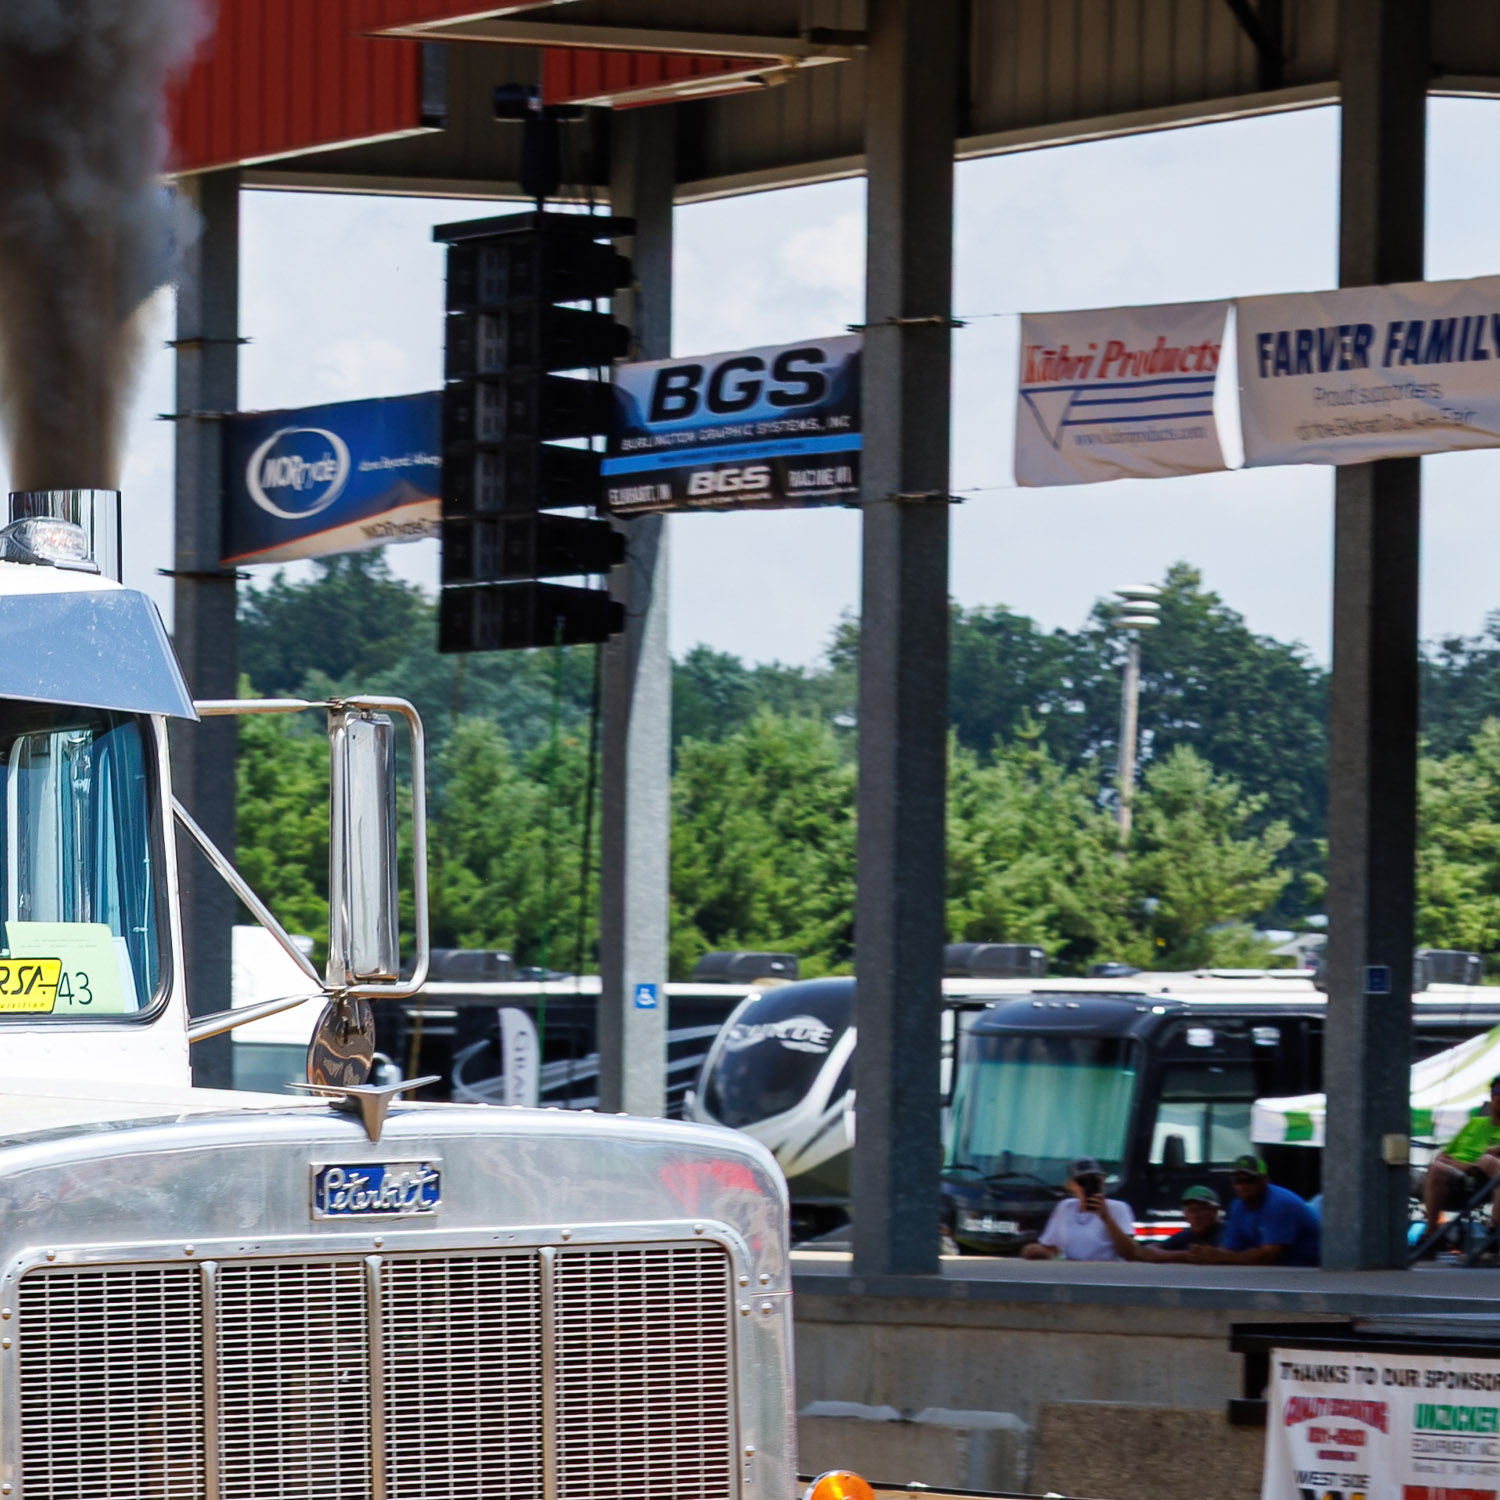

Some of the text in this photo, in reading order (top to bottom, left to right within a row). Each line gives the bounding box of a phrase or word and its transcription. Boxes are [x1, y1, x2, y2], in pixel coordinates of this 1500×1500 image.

[1097, 336, 1222, 379] Products
[1256, 323, 1375, 378] FARVER
[649, 347, 827, 423] BGS
[686, 465, 772, 496] BGS
[58, 971, 93, 1006] 43
[323, 1167, 442, 1215] Peterbilt
[1279, 1361, 1349, 1384] THANKS
[1354, 1365, 1378, 1386] TO
[1382, 1367, 1421, 1388] OUR
